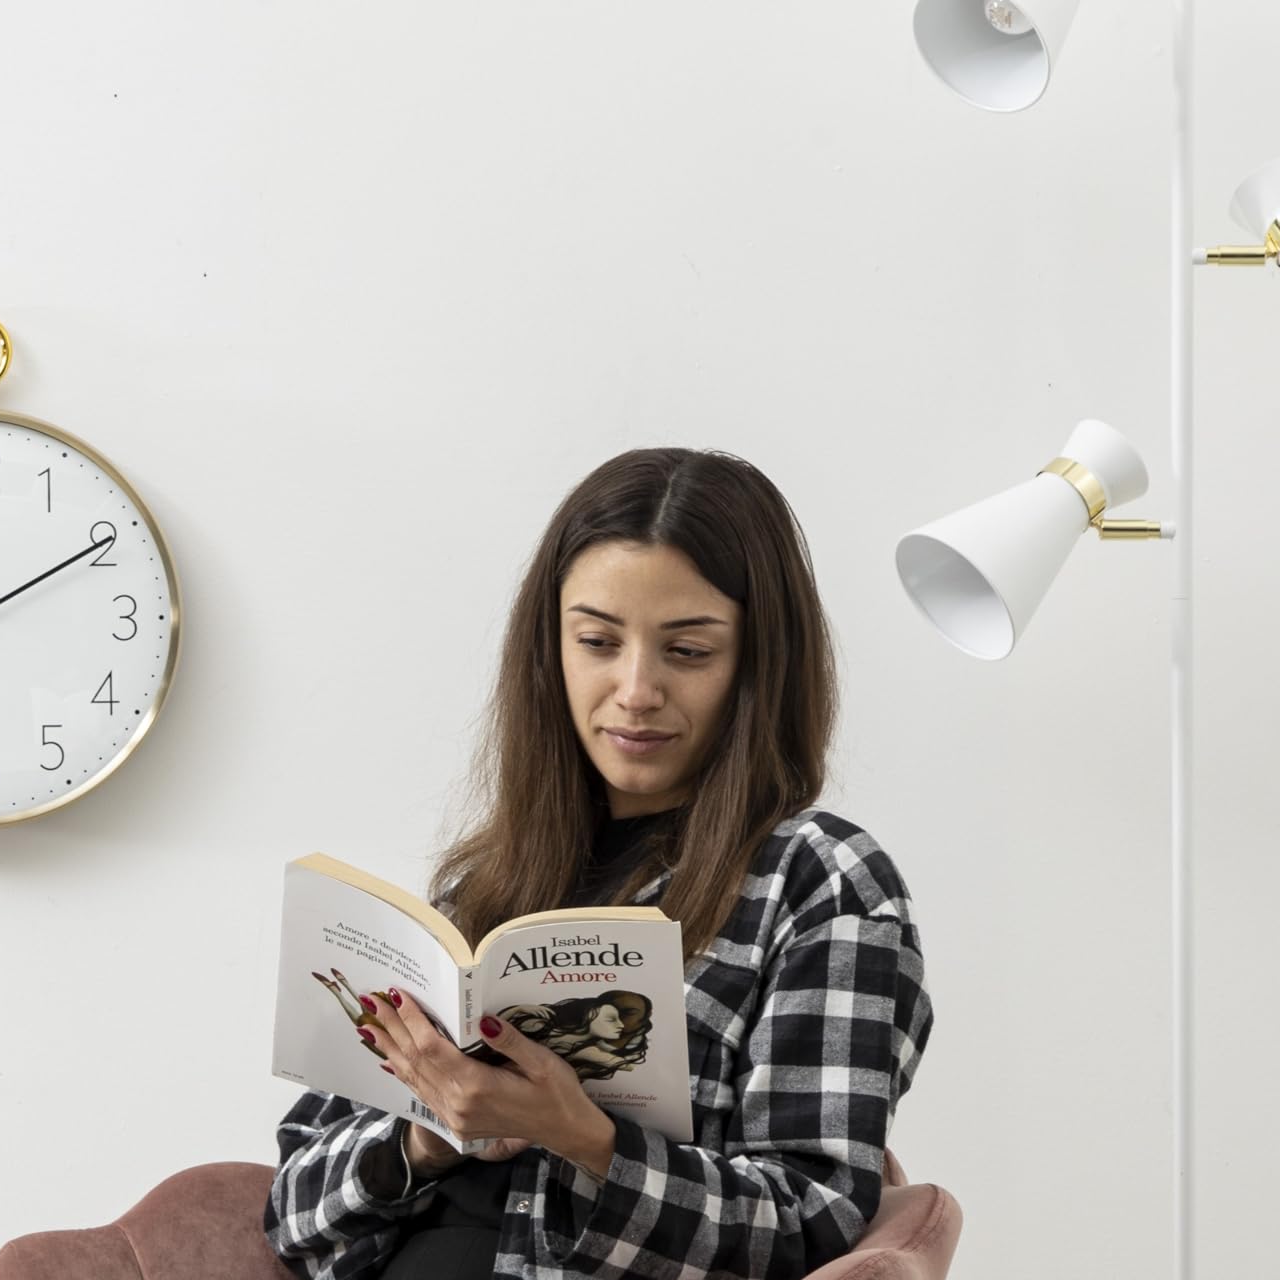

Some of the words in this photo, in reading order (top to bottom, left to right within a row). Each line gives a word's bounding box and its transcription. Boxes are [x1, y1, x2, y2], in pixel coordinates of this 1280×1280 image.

[37, 467, 51, 513] 1
[89, 521, 118, 567] 2
[112, 594, 138, 641] 3
[91, 670, 121, 717] 4
[40, 724, 65, 771] 5
[323, 927, 362, 945] secondo
[364, 942, 393, 961] Isabel
[325, 935, 334, 944] le
[336, 941, 354, 951] sue
[356, 949, 390, 968] pagine
[336, 922, 370, 939] Amore
[380, 941, 421, 969] desiderio
[499, 943, 644, 979] Allende
[550, 935, 602, 948] Isabel
[540, 970, 617, 984] Amore
[624, 1093, 657, 1101] Allende
